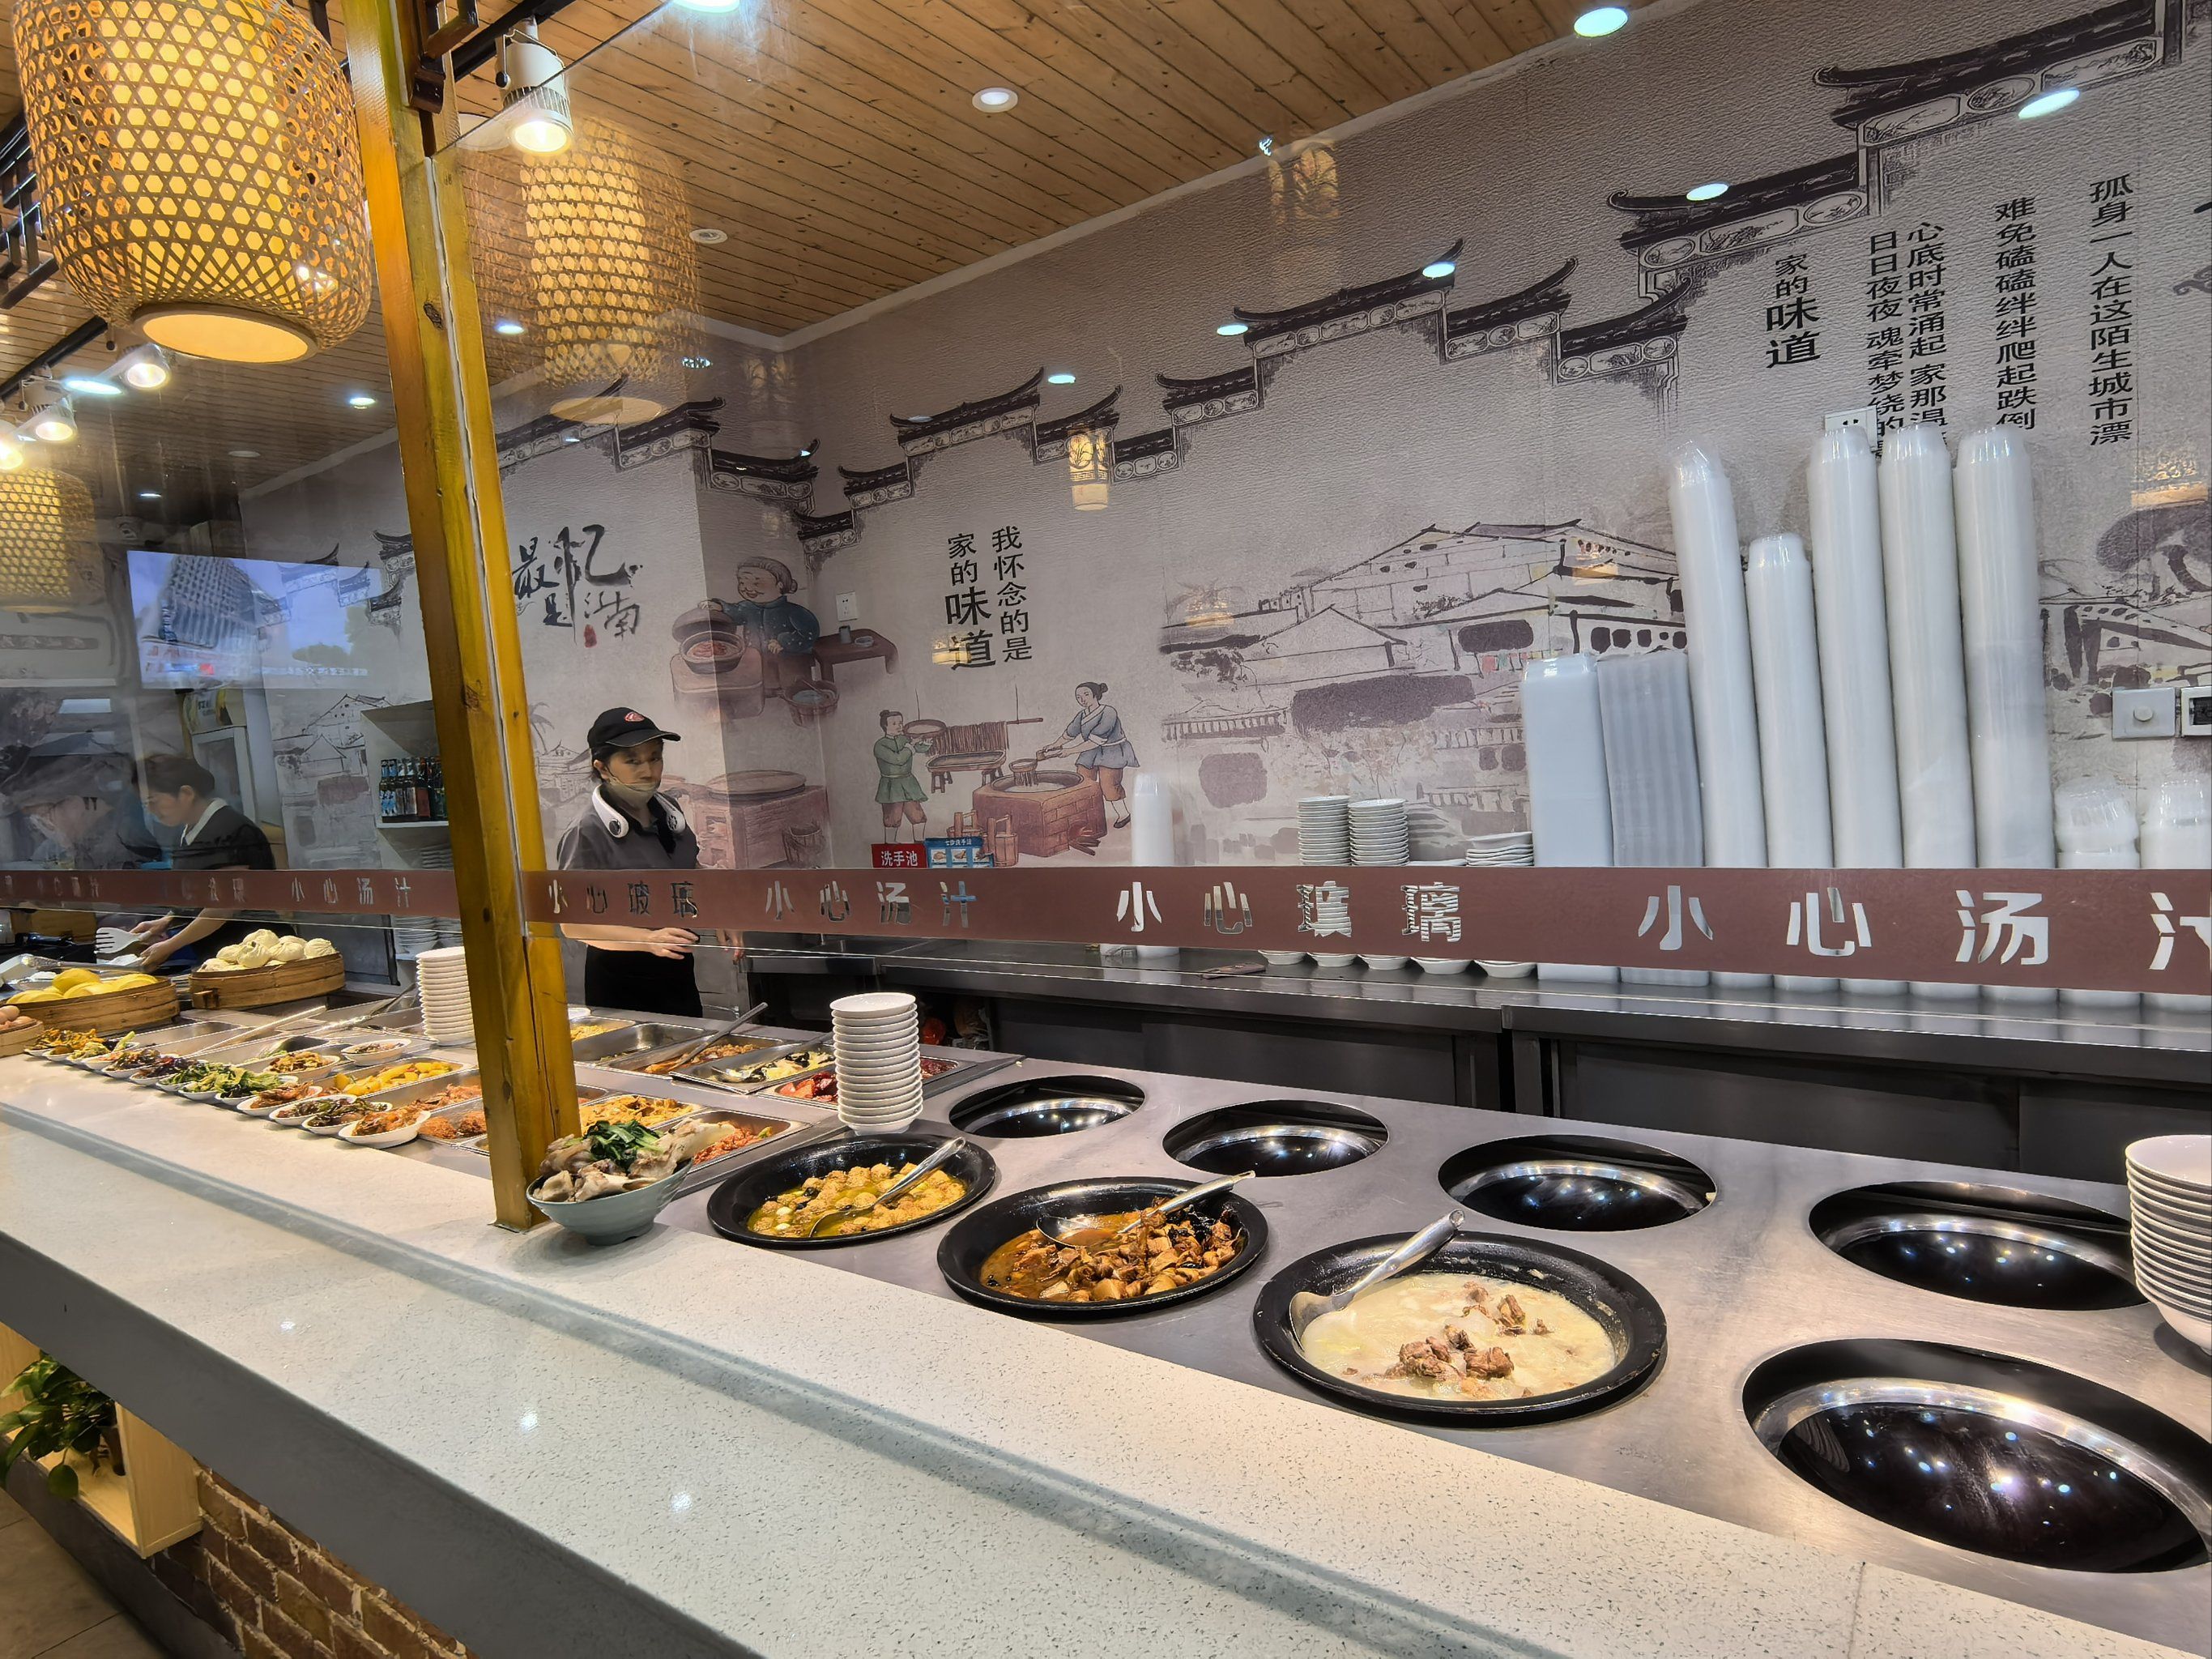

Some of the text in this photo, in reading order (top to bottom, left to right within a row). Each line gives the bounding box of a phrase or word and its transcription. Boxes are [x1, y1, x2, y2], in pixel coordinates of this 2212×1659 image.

[1764, 253, 1822, 369] 家的味道
[1865, 229, 1906, 456] 日日夜夜魂牵梦绕的
[1906, 220, 1949, 446] 心底时常涌起家那温
[1994, 196, 2038, 430] 难免磕磕绊绊爬起跌倒
[2087, 173, 2134, 446] 孤身一人在这陌生城市漂
[944, 532, 996, 671] 家的味道
[991, 525, 1033, 664] 我怀念的是
[764, 879, 977, 928] 小心汤汁
[880, 850, 918, 867] 洗手池
